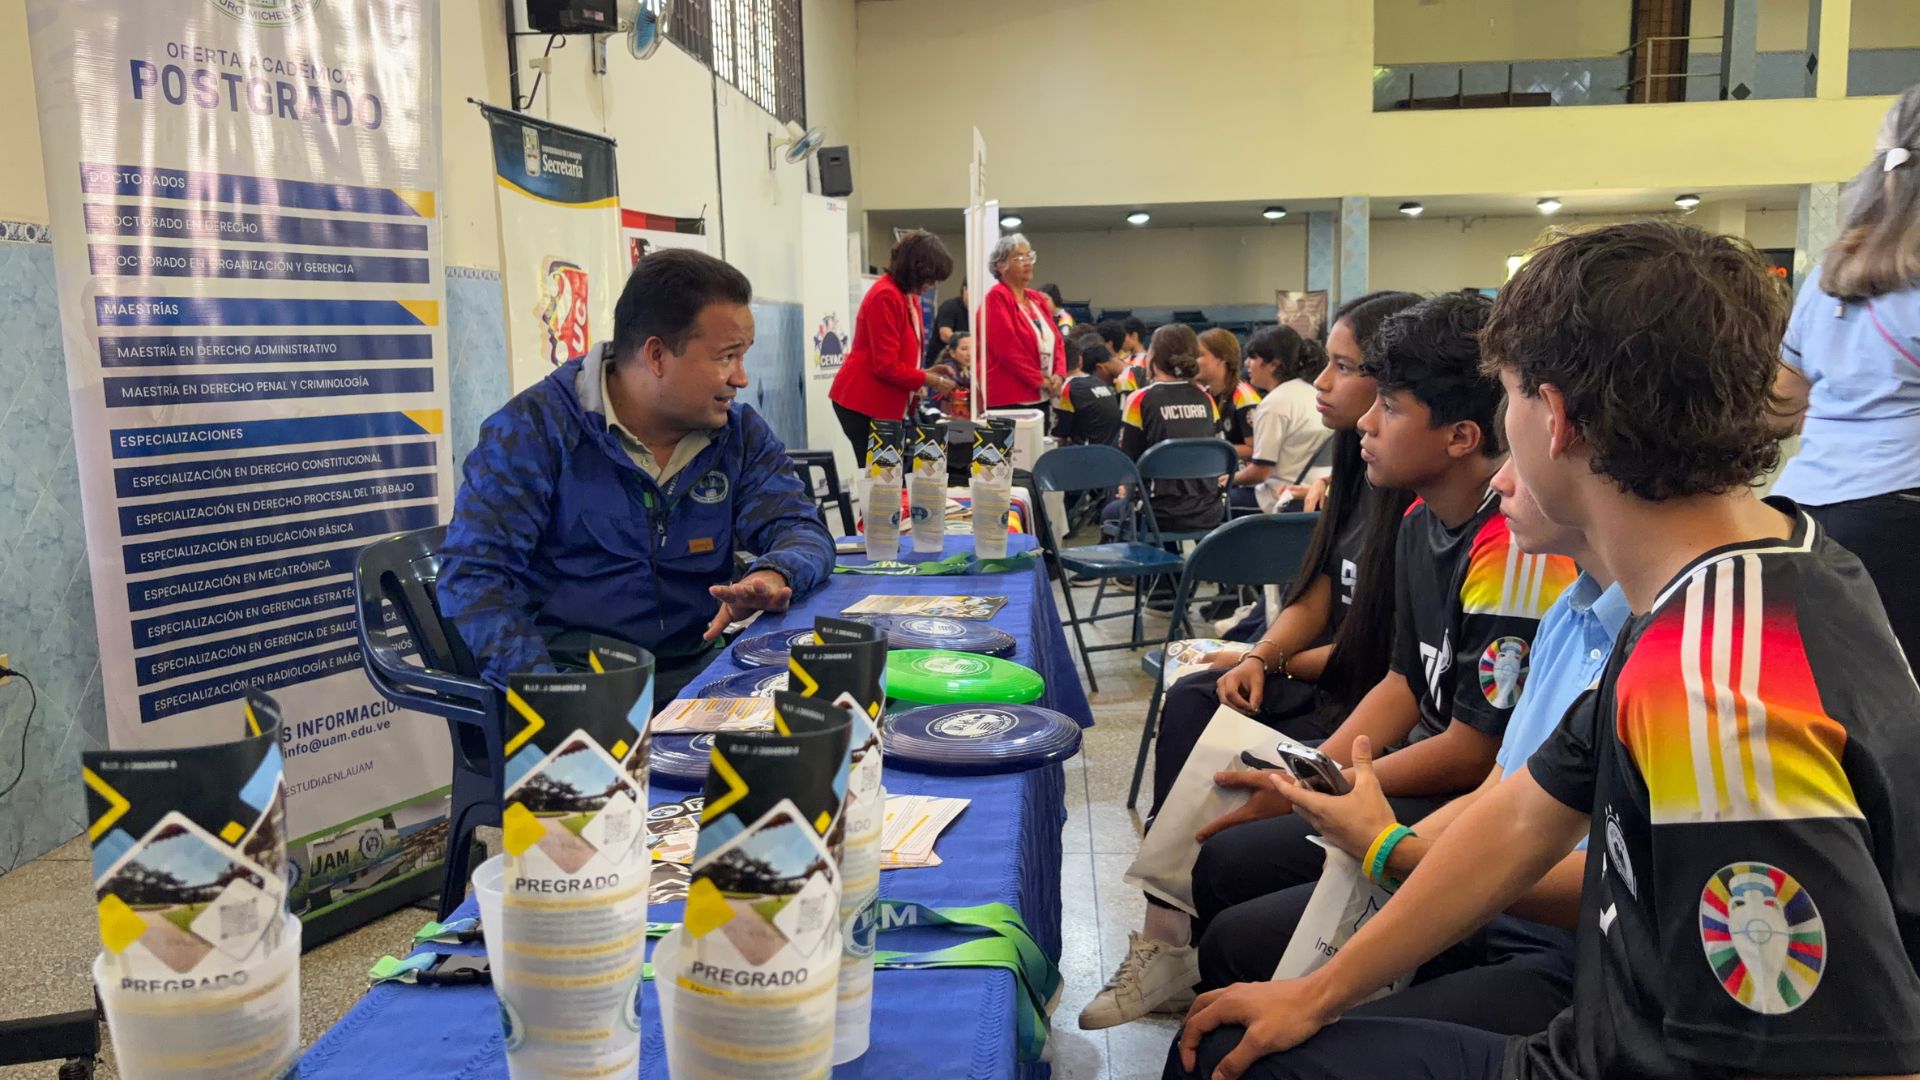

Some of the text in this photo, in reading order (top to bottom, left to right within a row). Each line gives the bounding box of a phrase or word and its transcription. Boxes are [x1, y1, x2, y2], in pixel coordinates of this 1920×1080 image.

[167, 42, 356, 85] OFERTA ACADÉMICA
[130, 59, 383, 131] POSTGRADO
[542, 154, 584, 179] Secretaría
[89, 171, 186, 189] DOCTORADOS
[101, 215, 183, 231] DOCTORADO
[205, 220, 259, 235] DERECHO
[106, 255, 187, 270] DOCTORADO
[209, 256, 294, 272] ORGANIZACIÓN
[296, 262, 303, 272] Y
[304, 262, 355, 275] GERENCIA
[104, 301, 180, 316] MAESTRÍAS
[117, 343, 338, 359] MAESTRÍA EN DERECHO ADMINISTRATIVO
[121, 376, 370, 398] MAESTRÍA EN DERECHO PENAL Y CRIMINOLOGÍA
[1160, 404, 1207, 420] VICTORIA
[119, 428, 244, 448] ESPECIALIZACIONES
[132, 453, 383, 488] ESPECIALIZACIÓN EN DERECHO CONSTITUCIONAL
[136, 482, 415, 527] ESPECIALIZACIÓN EN DERECHO PROCESAL DEL TRABAJO
[140, 521, 355, 564] ESPECIALIZACIÓN EN EDUCACIÓN BÁSICA
[144, 559, 332, 601] ESPECIALIZACIÓN EN MECATRÓNICA
[148, 587, 355, 638] ESPECIALIZACIÓN EN GERENCIA ESTRATÉ
[151, 643, 247, 675] ESPECIALIZACIÓN
[249, 640, 262, 652] EN
[264, 630, 315, 649] GERENCIA
[316, 626, 328, 638] DE
[154, 651, 361, 712] ESPECIALIZACIÓN EN RADIOLOGÍA E IMÁG
[515, 873, 620, 893] PREGRADO
[692, 961, 808, 987] PREGRADO
